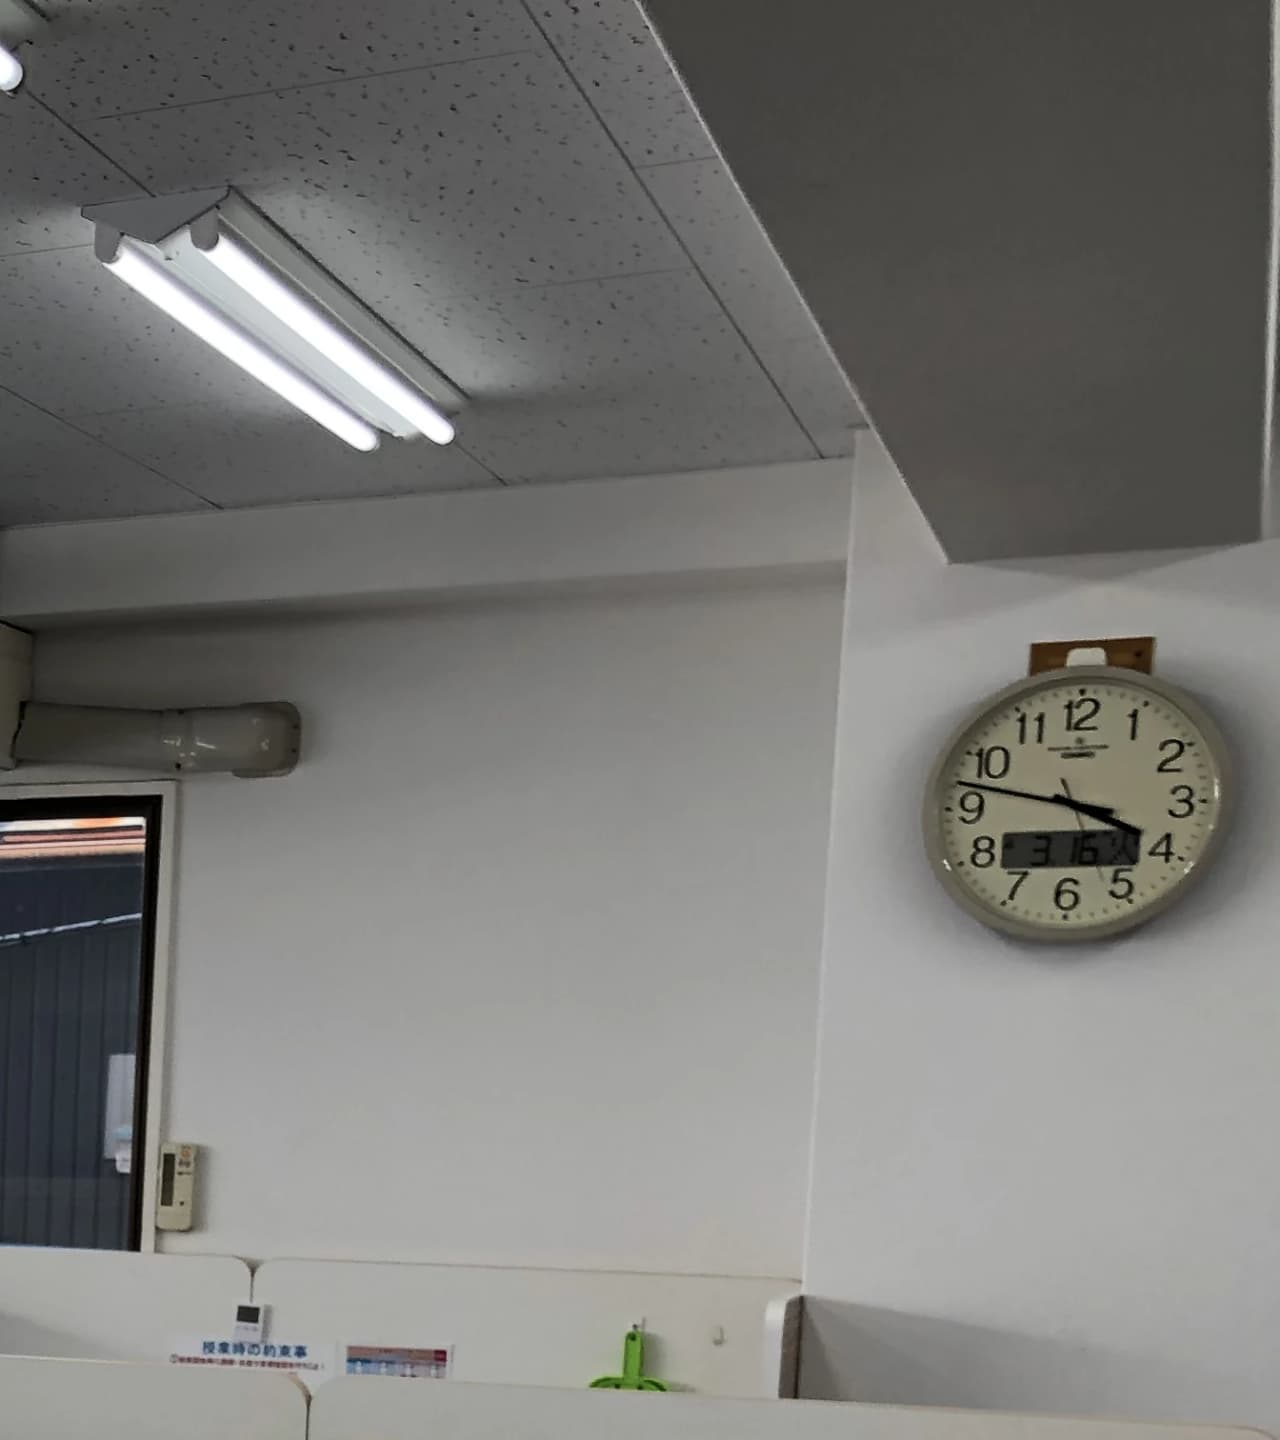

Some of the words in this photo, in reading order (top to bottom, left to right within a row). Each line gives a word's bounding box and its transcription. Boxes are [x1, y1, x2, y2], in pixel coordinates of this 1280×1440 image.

[1017, 711, 1045, 745] 11
[1064, 697, 1101, 731] 12
[1128, 708, 1139, 741] 1
[975, 745, 1010, 779] 10
[1156, 738, 1185, 773] 2
[958, 790, 985, 825] 9
[1167, 784, 1195, 819] 3
[970, 835, 995, 868] 8
[1147, 832, 1176, 863] 4
[1006, 870, 1030, 901] 7
[1053, 877, 1081, 911] 6
[1108, 868, 1135, 900] 5
